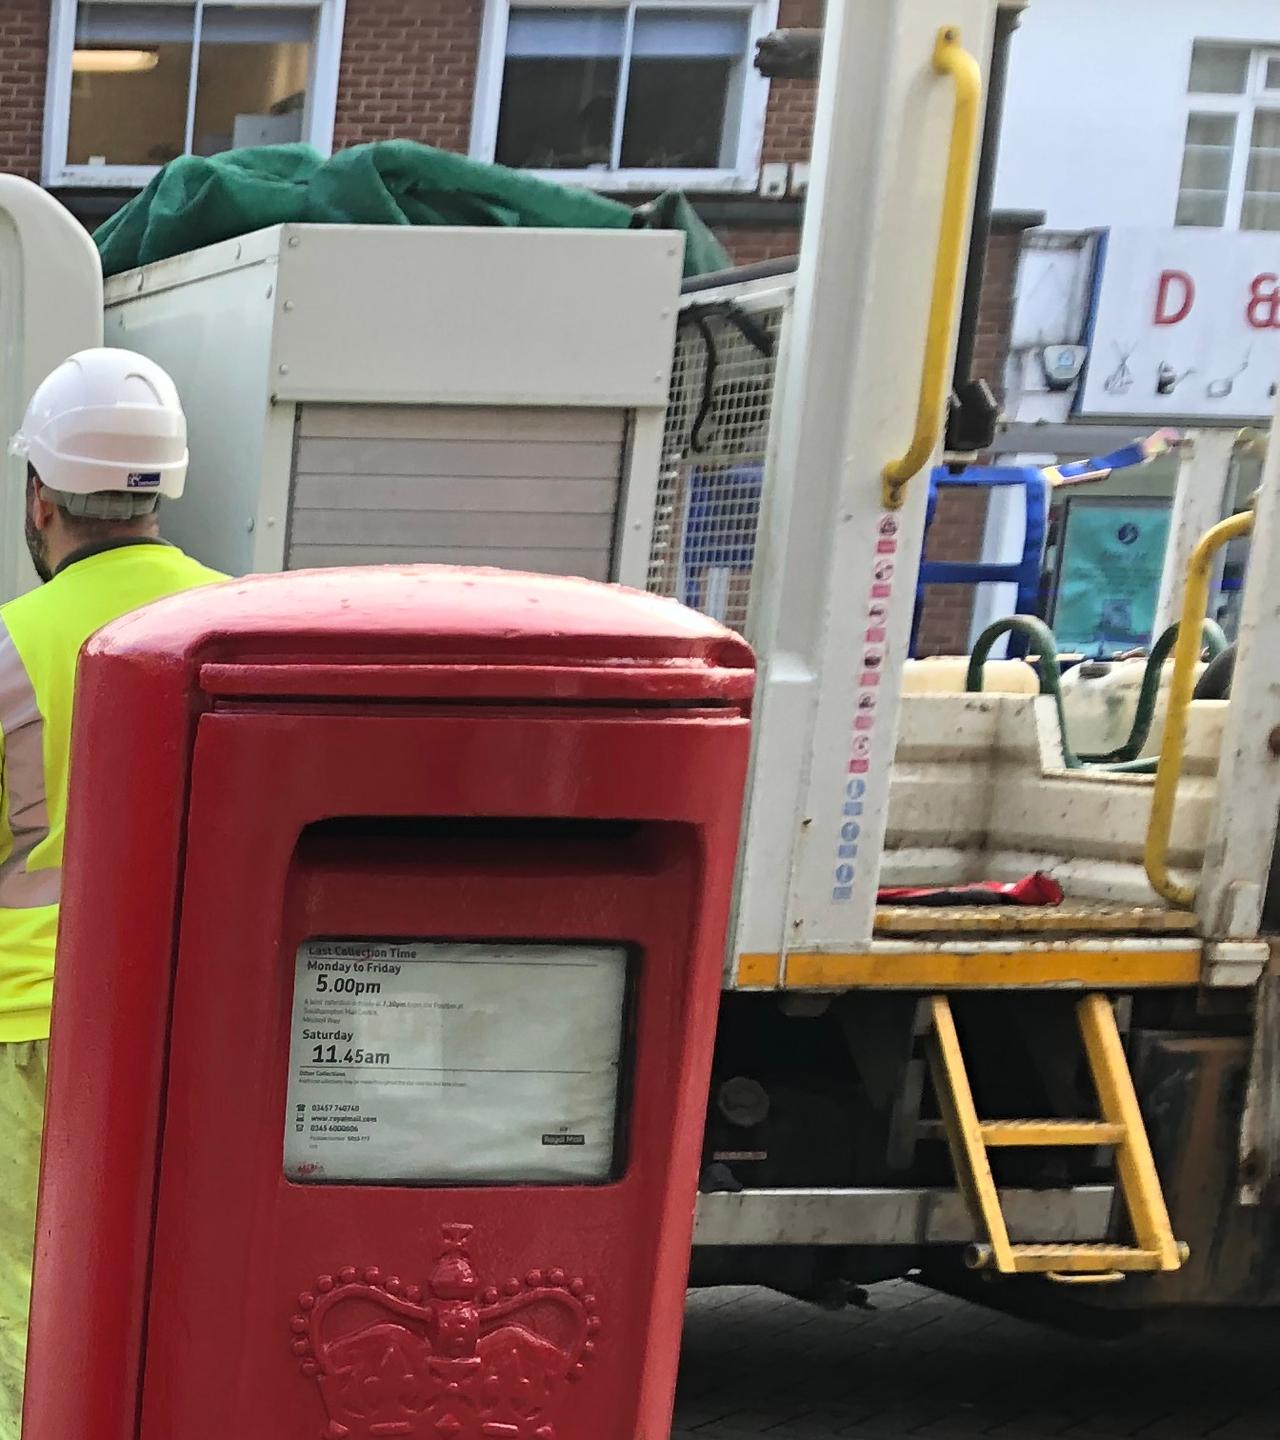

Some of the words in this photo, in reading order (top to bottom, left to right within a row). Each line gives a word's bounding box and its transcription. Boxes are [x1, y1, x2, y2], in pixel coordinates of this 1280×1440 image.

[1154, 269, 1195, 325] D
[1247, 271, 1280, 328] &
[308, 947, 333, 957] Last
[335, 948, 388, 959] Collection
[389, 949, 417, 959] Time
[307, 960, 351, 974] Monday
[353, 963, 364, 972] to
[366, 963, 402, 976] Friday
[316, 974, 381, 996] 5.00pm
[302, 1028, 354, 1042] Saturday
[312, 1044, 390, 1065] 11.45am
[312, 1104, 333, 1112] 03457
